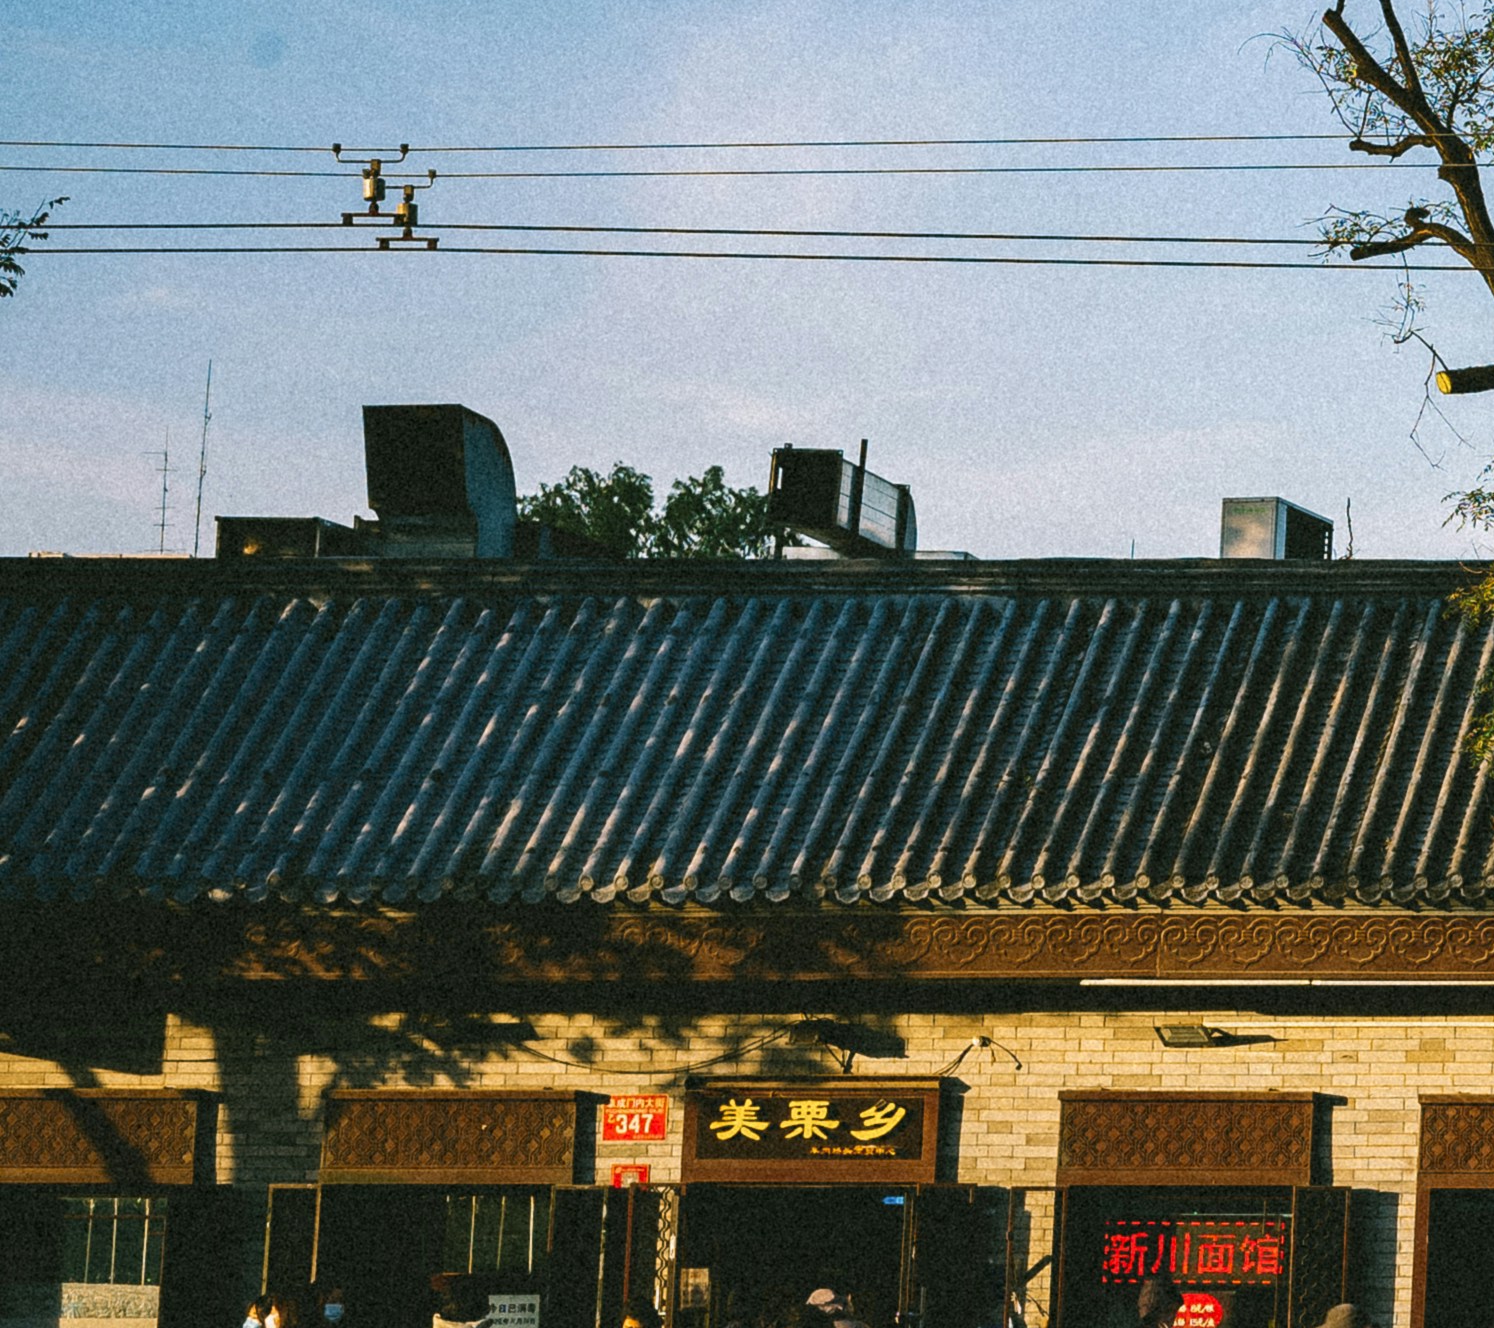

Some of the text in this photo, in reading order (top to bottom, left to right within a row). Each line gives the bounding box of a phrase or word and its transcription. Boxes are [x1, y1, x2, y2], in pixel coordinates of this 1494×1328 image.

[616, 1113, 654, 1134] 347
[709, 1098, 907, 1141] 美栗乡
[1109, 1232, 1280, 1276] 新川面馆
